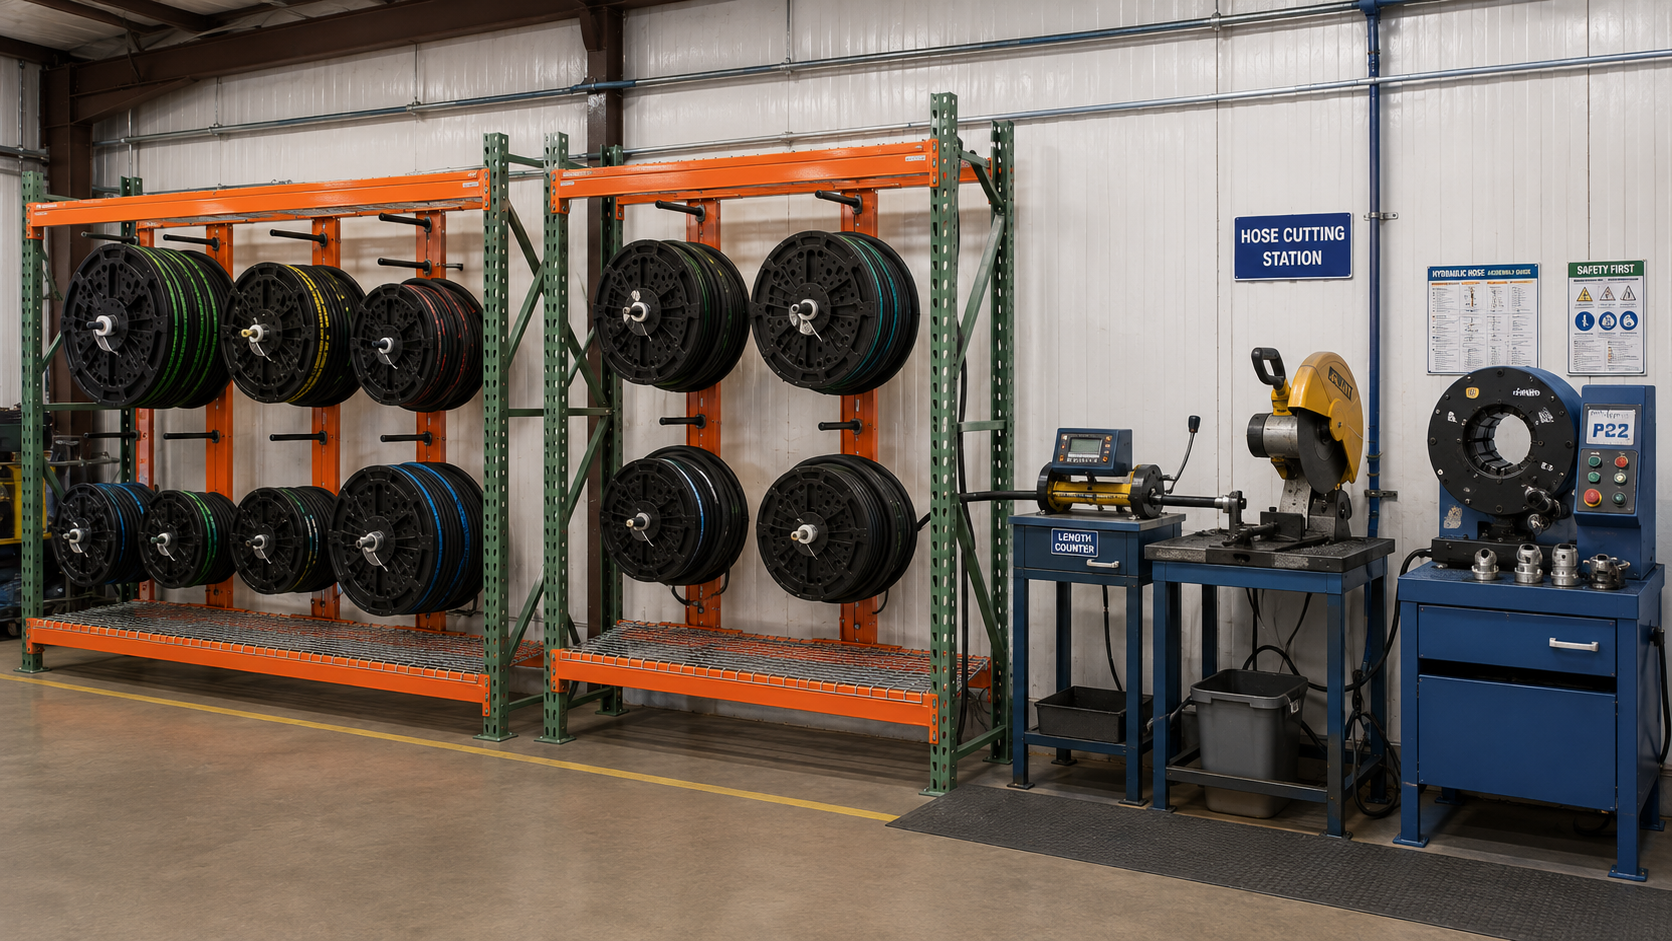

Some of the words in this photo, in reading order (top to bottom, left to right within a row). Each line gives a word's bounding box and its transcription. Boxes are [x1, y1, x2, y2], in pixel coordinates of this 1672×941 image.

[1241, 228, 1279, 244] HOSE
[1283, 225, 1345, 242] CUTTING
[1263, 250, 1322, 266] STATION
[1577, 265, 1608, 275] SAFETY
[1610, 264, 1635, 274] FIRST
[1592, 423, 1629, 438] P22
[1054, 542, 1095, 554] COUNTER
